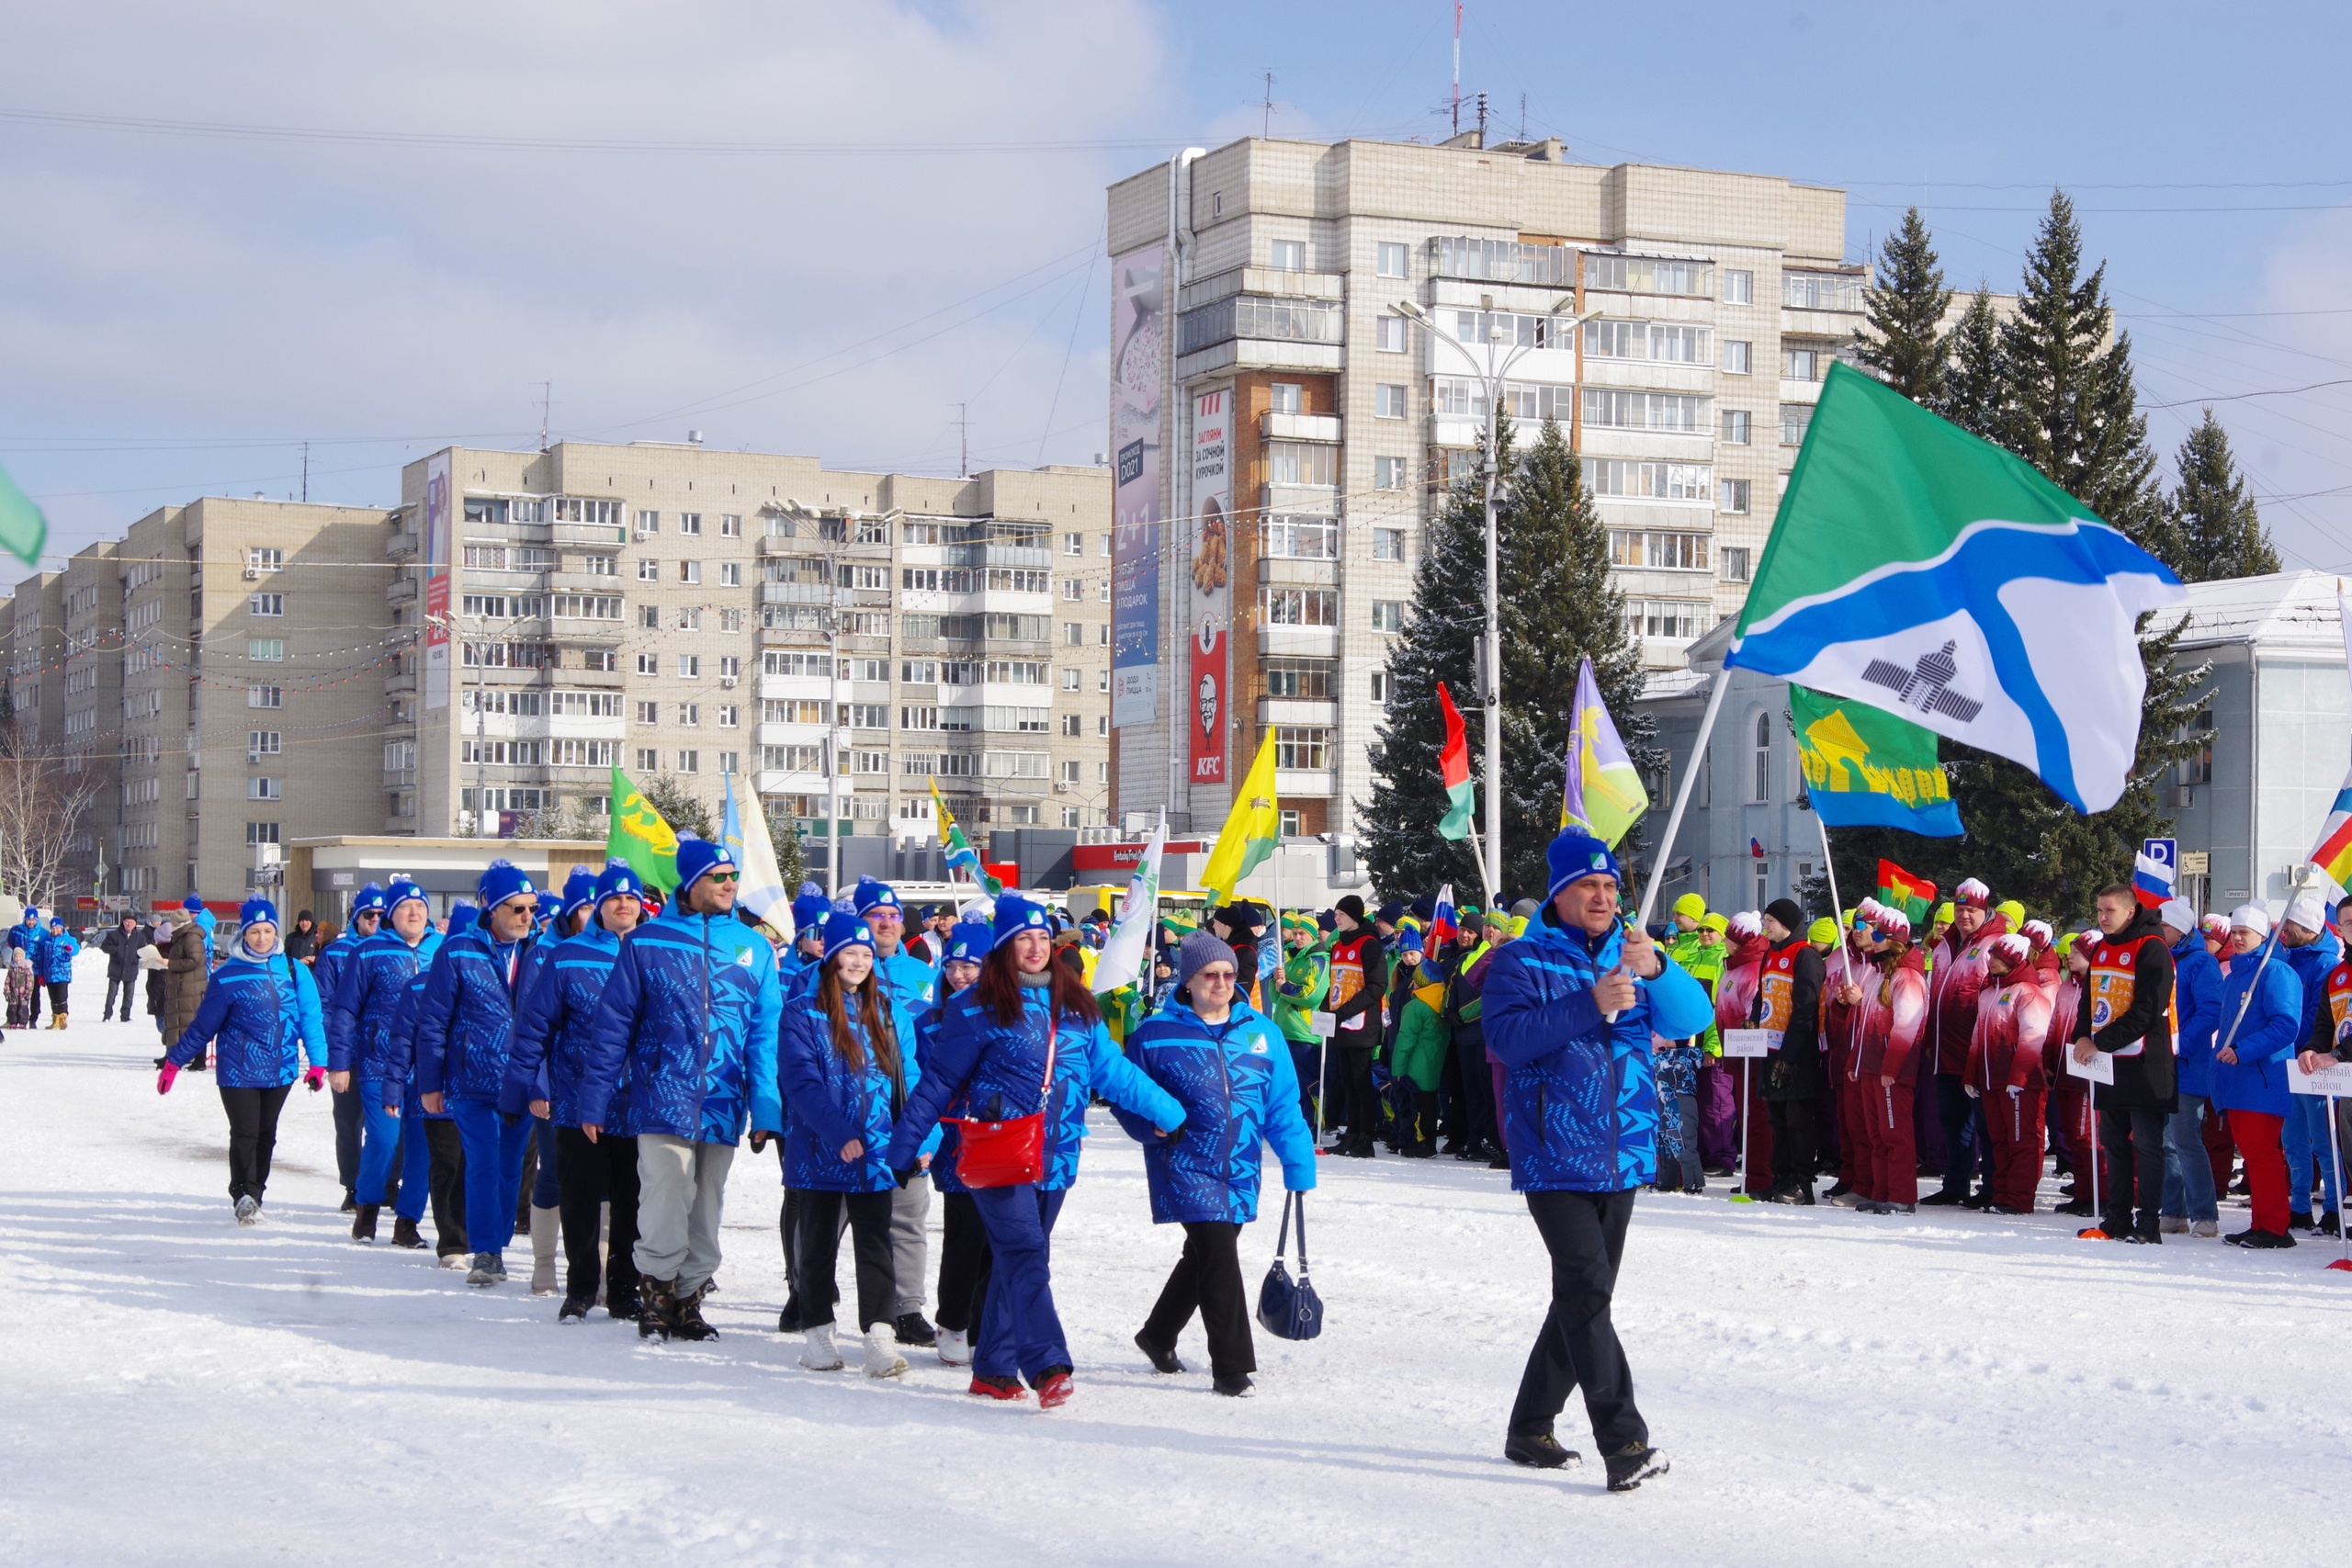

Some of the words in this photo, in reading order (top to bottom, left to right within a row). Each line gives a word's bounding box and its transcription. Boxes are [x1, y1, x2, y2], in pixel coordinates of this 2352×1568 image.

[1198, 427, 1222, 445] ЗАГЛЯНИ
[1196, 450, 1201, 462] ЗА
[1203, 440, 1225, 461] СОЧНОЙ
[1195, 457, 1224, 479] КУРОЧКОЙ
[1117, 502, 1149, 551] 2+1
[1116, 579, 1136, 593] ПИЦЦА
[1120, 593, 1148, 609] ПОДАРОК
[1126, 675, 1139, 684] ДОДО
[1126, 686, 1142, 695] ПИЦЦА
[1196, 755, 1220, 776] KFC
[1727, 1032, 1764, 1042] Мошковский
[1736, 1043, 1754, 1055] район
[2094, 1058, 2109, 1073] Обь
[2312, 1066, 2351, 1078] верный
[2311, 1078, 2342, 1092] район
